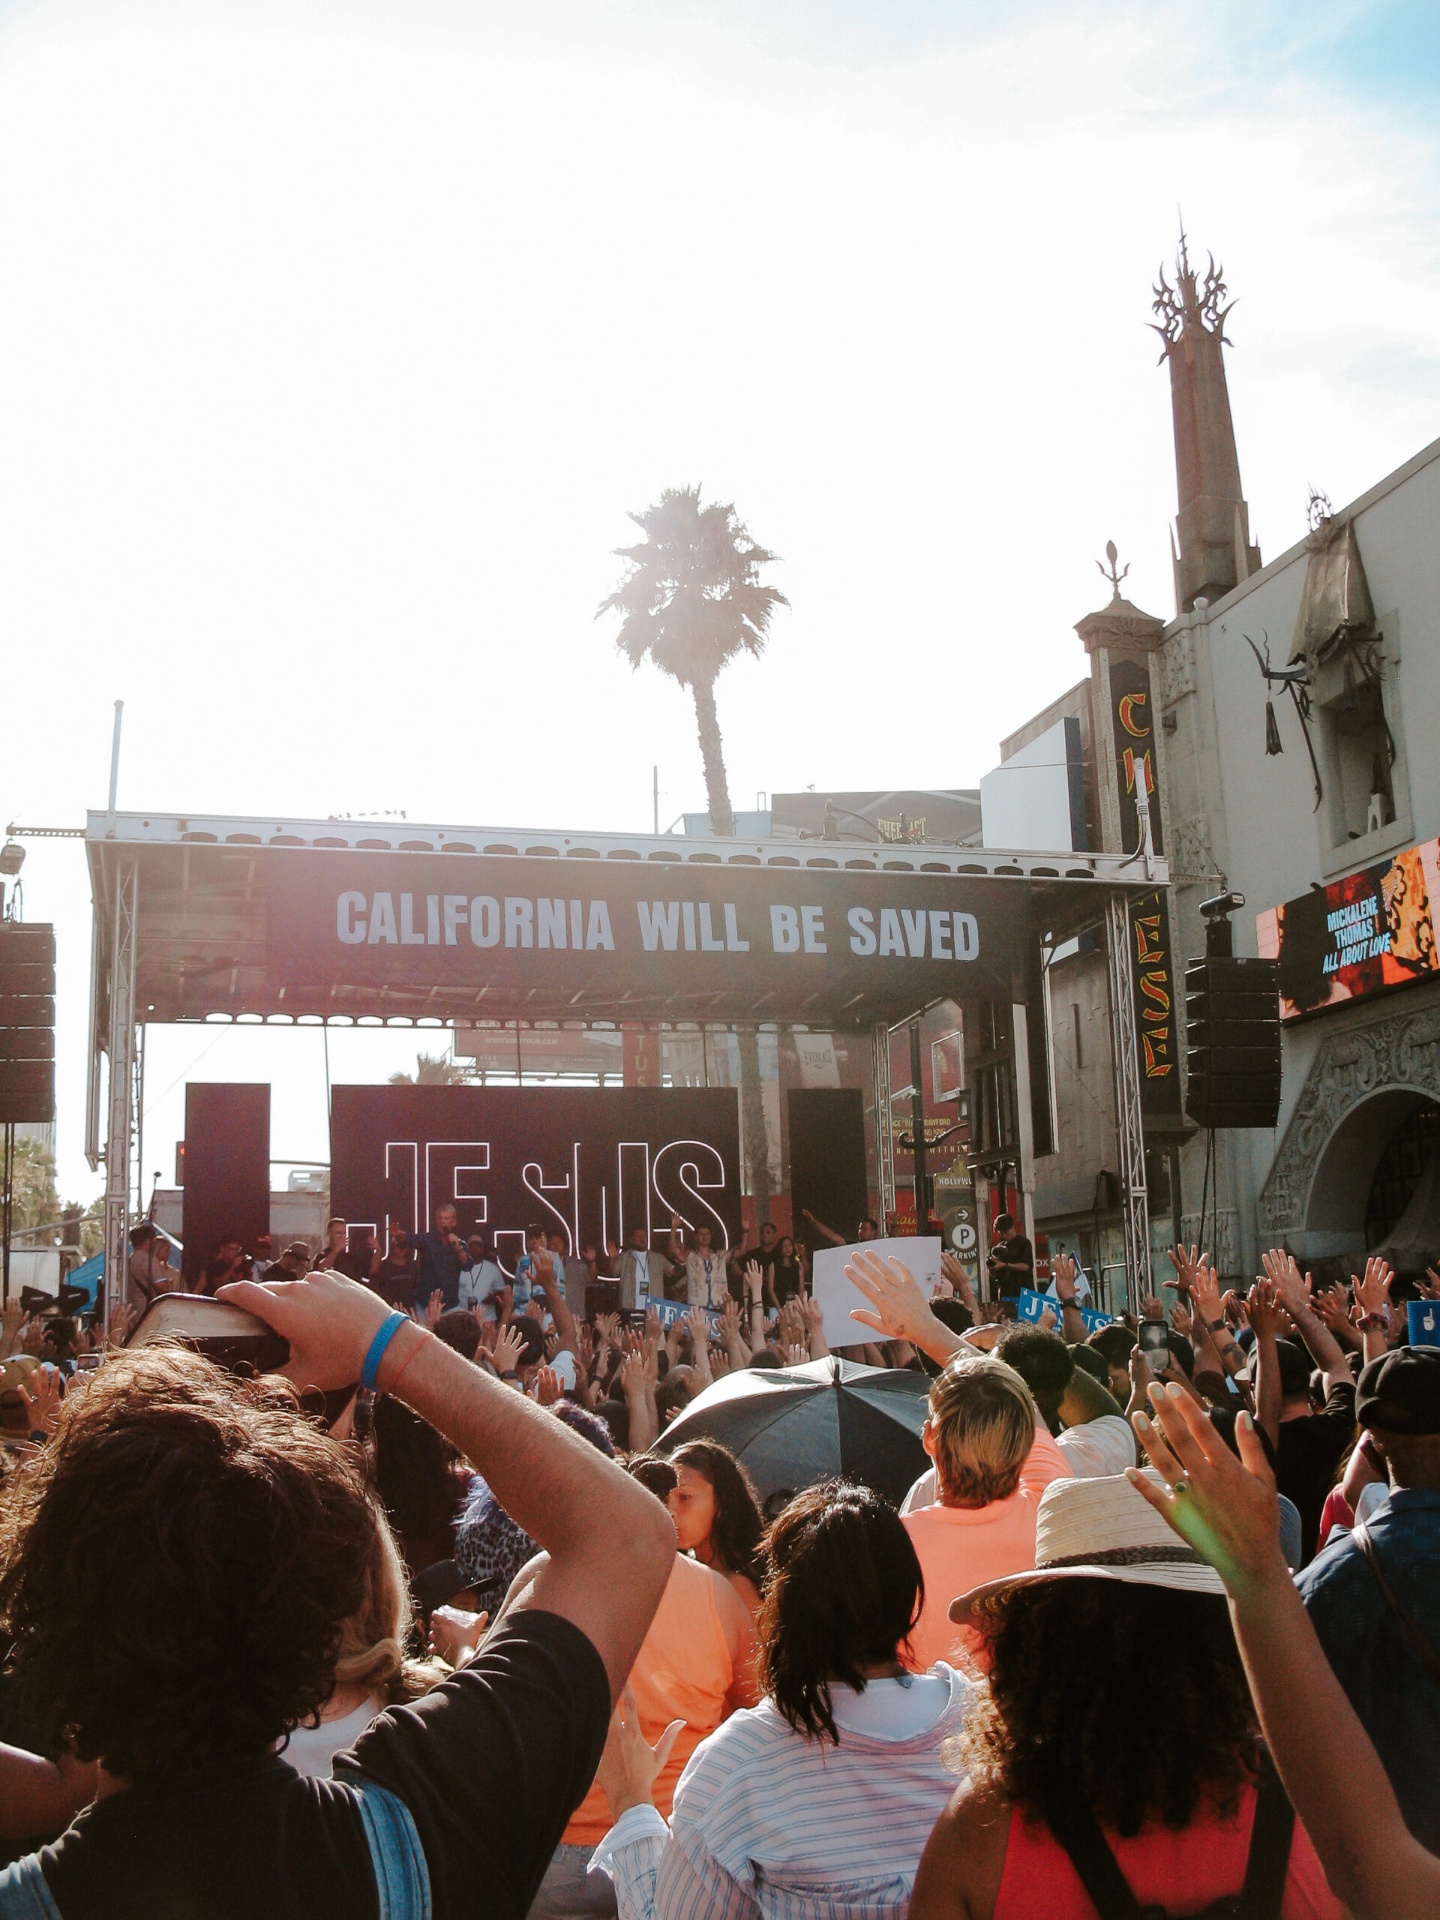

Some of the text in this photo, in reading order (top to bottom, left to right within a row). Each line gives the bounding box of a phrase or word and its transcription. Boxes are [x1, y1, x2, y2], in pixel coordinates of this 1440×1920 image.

[1118, 692, 1173, 1078] CHESE
[336, 890, 980, 961] CALIFORNIA WILL BE SAVED
[1327, 895, 1378, 932] MICKALENE
[1334, 918, 1374, 949] THOMAS
[1322, 931, 1391, 974] ALL ABOUT LOVE
[939, 1177, 972, 1185] HOLLYW
[345, 1140, 730, 1282] JESUS
[949, 1247, 977, 1260] PARKIN
[960, 1228, 970, 1244] P
